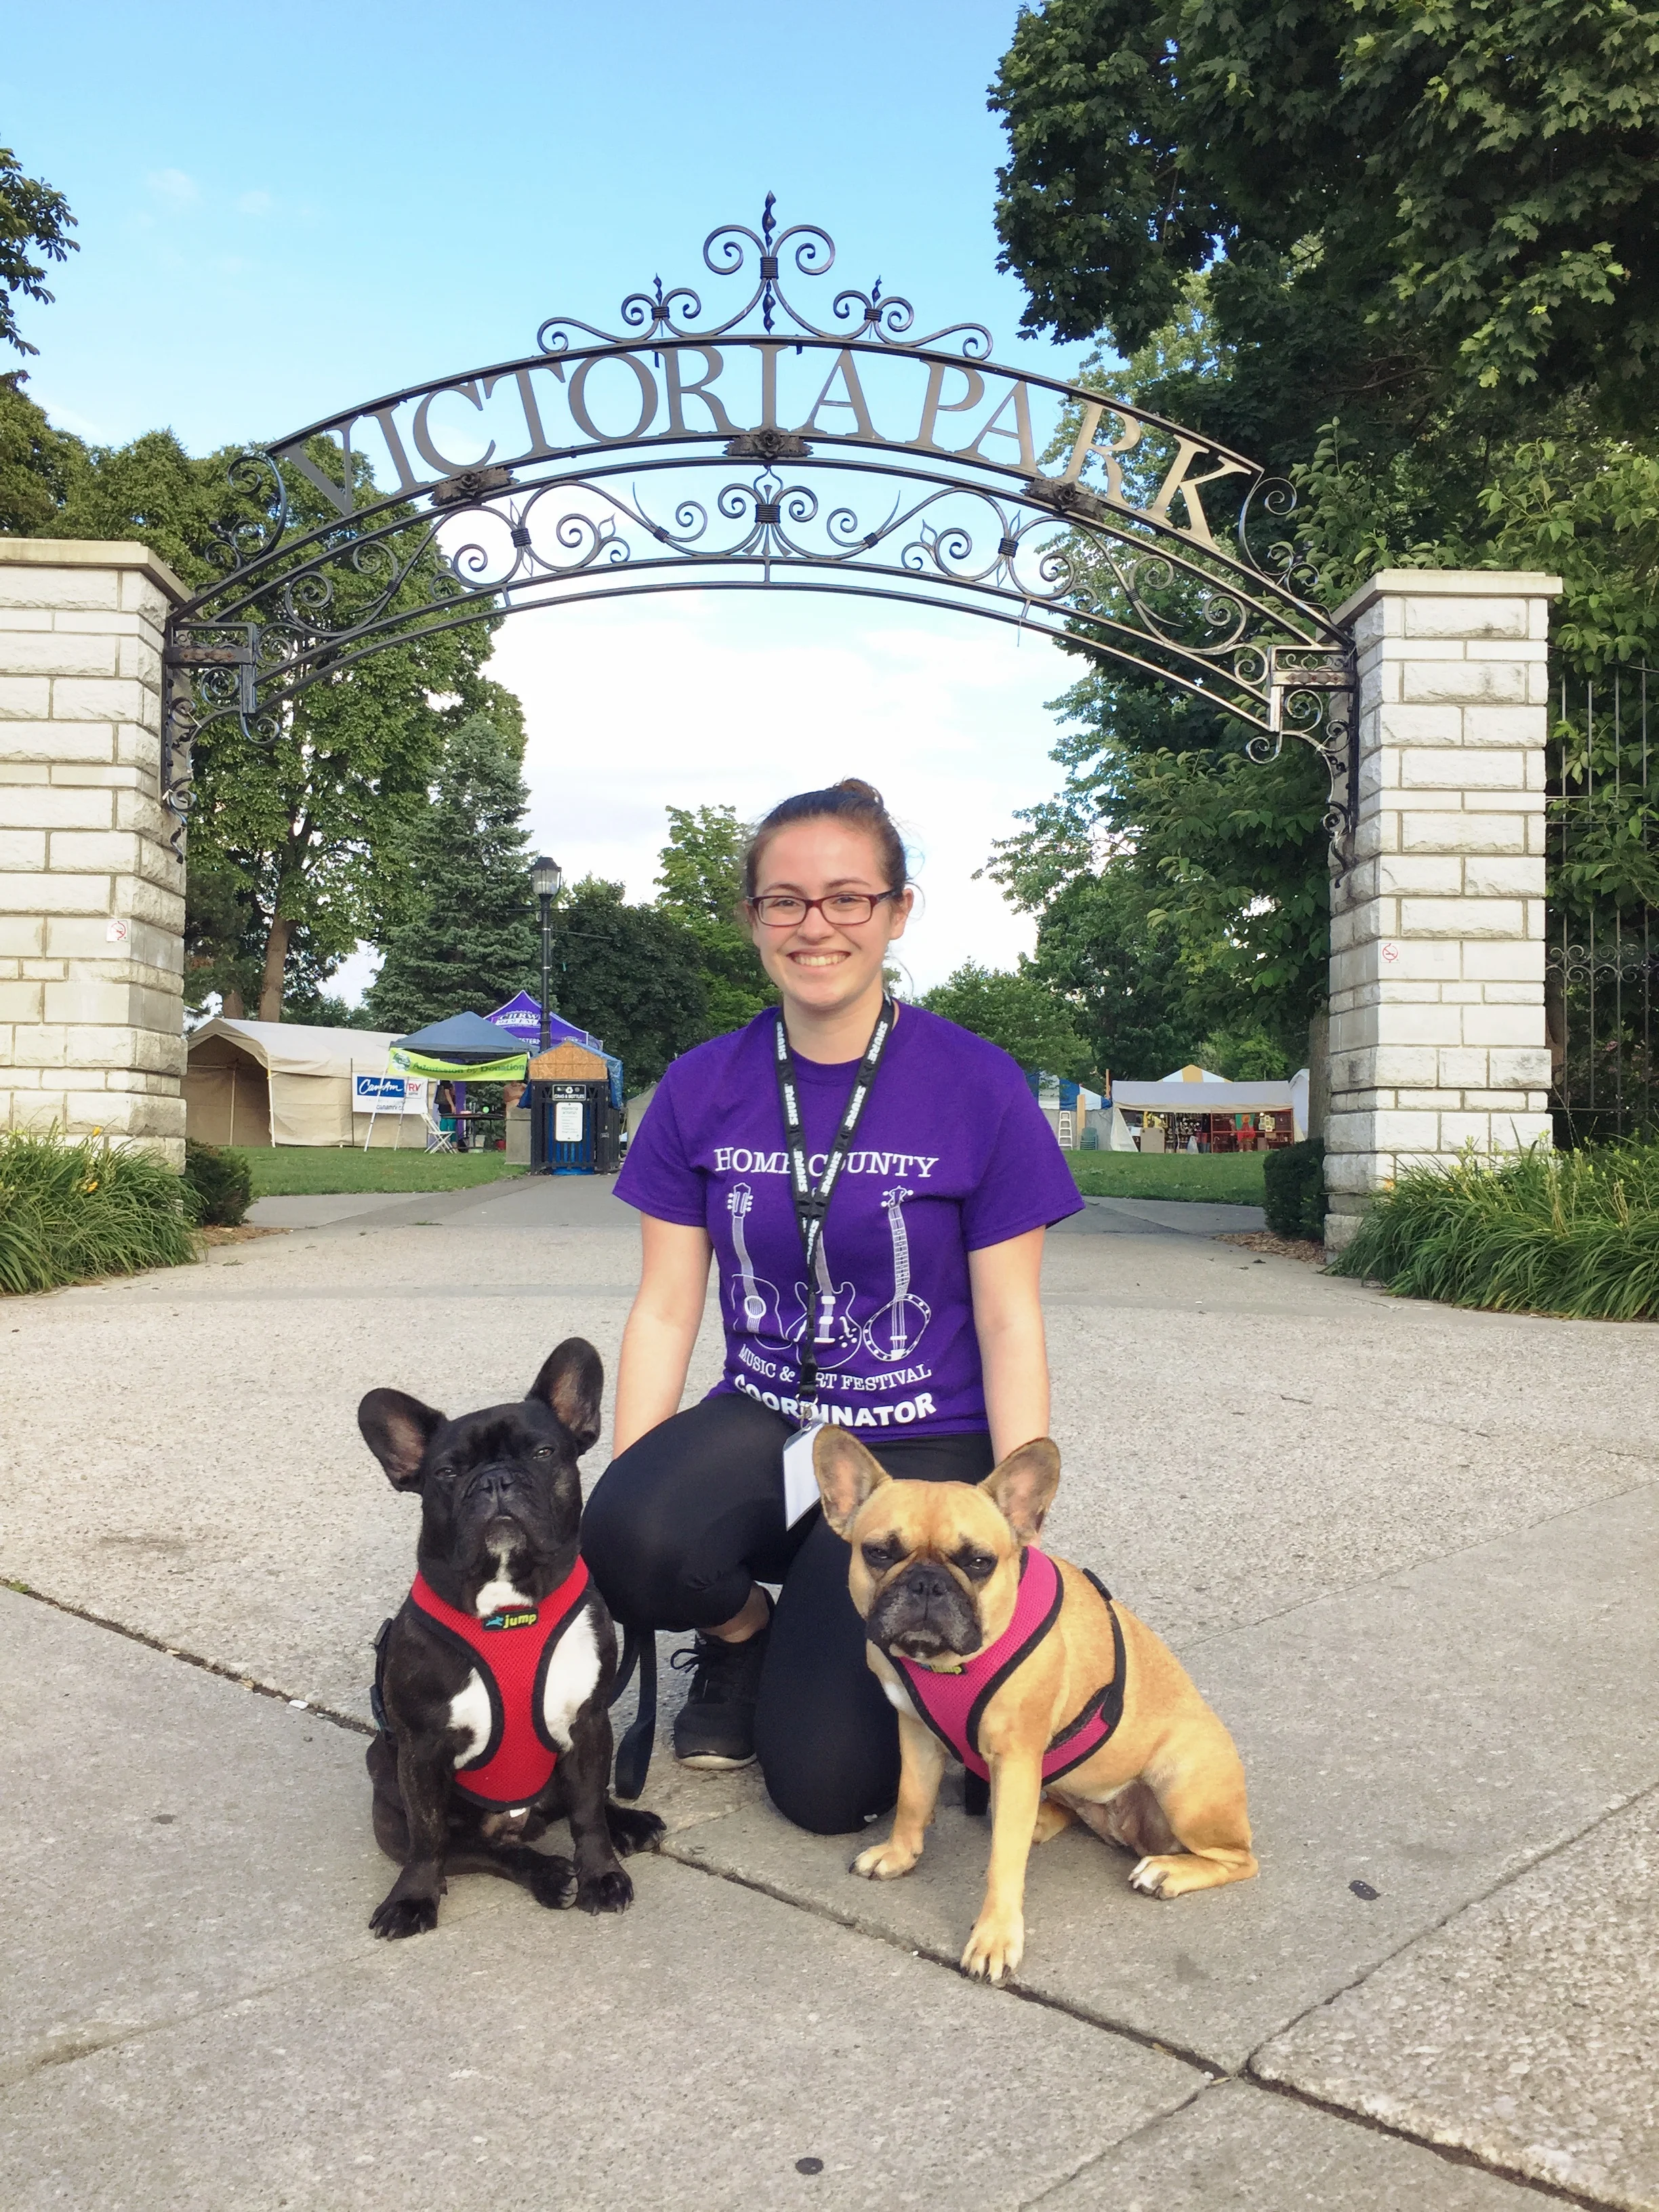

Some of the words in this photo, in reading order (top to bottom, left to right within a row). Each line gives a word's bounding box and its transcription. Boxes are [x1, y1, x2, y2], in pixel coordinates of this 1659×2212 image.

[275, 344, 886, 518] VICTORIA
[905, 359, 1252, 552] PARK
[867, 1021, 888, 1063] SHURE
[409, 1083, 422, 1092] RV
[480, 1064, 525, 1072] Donation
[784, 1084, 799, 1126] SHURE
[844, 1086, 866, 1130] SHURE
[793, 1149, 808, 1193] SHURE
[808, 1151, 939, 1178] CUNTY
[821, 1151, 842, 1196] SHURE
[738, 1343, 777, 1378] MUSIC
[779, 1366, 796, 1383] &
[798, 1371, 838, 1389] RT
[840, 1364, 933, 1391] FESTIVAL
[735, 1373, 937, 1427] COORDINATOR
[503, 1614, 537, 1629] jump
